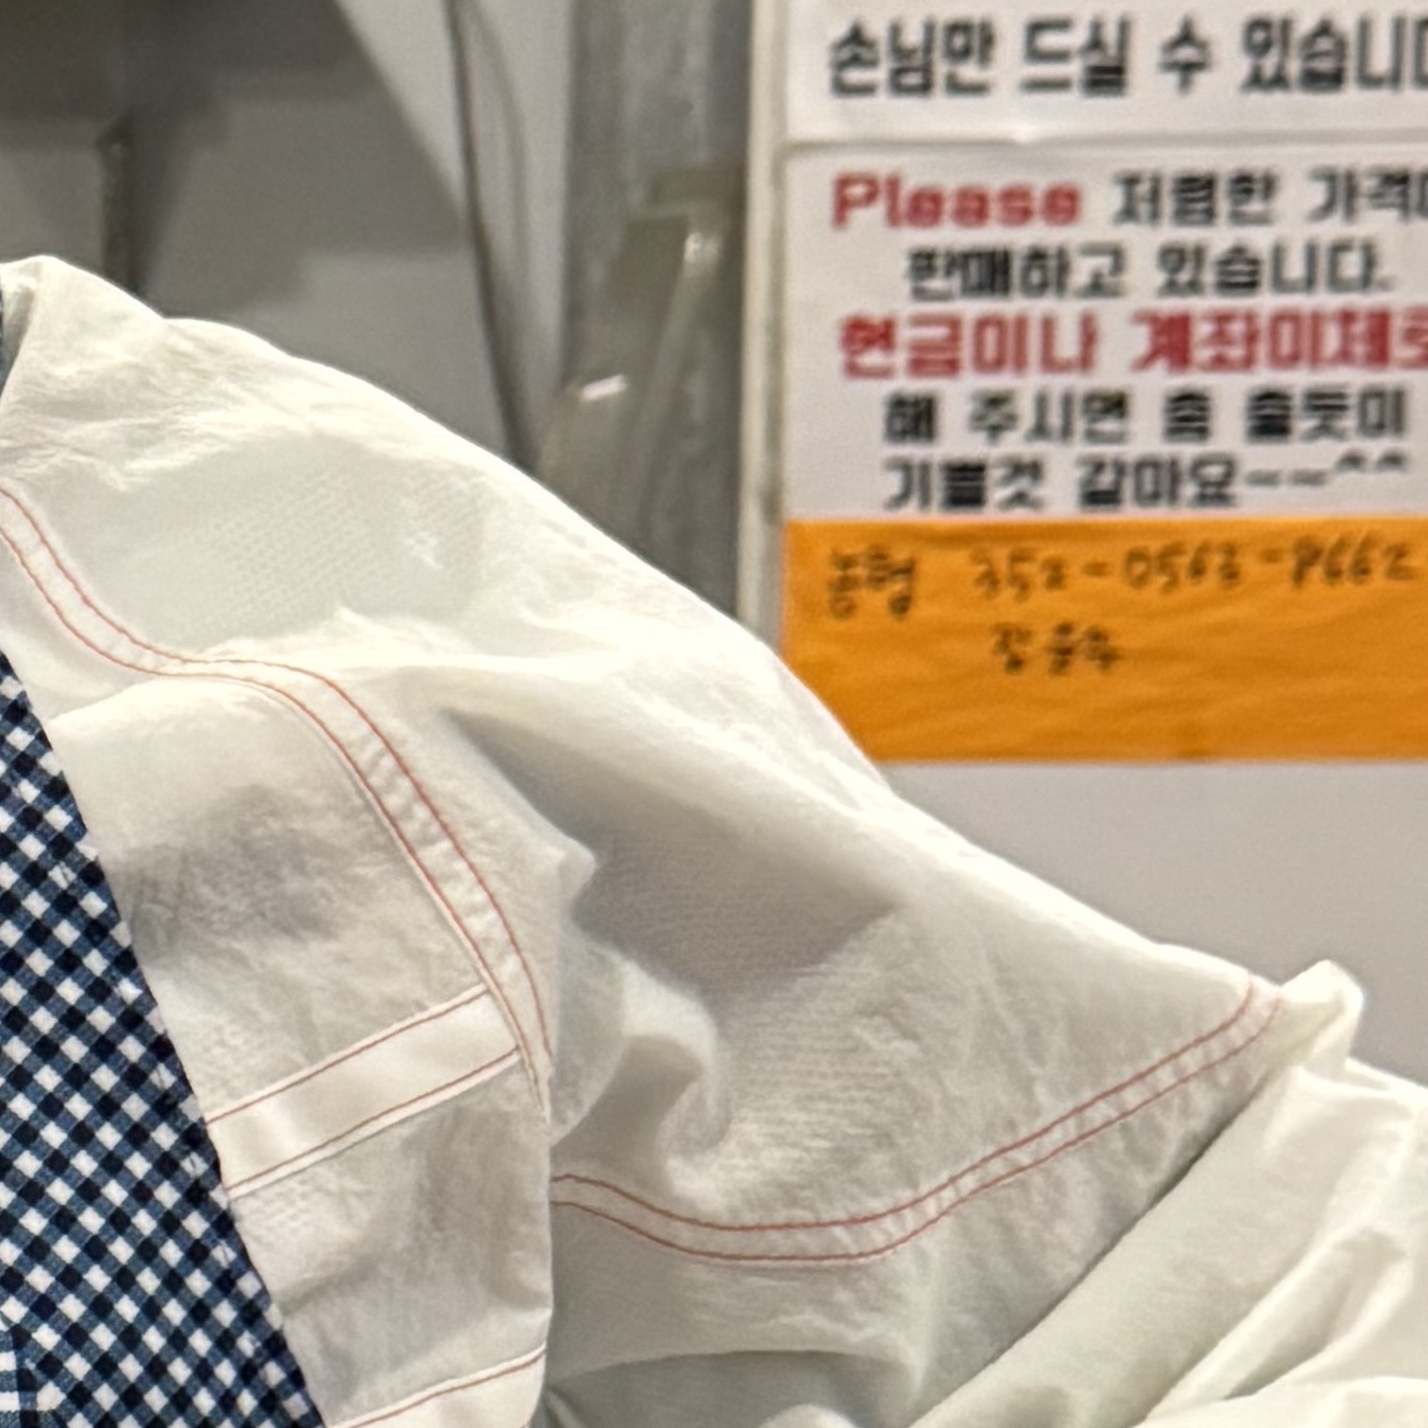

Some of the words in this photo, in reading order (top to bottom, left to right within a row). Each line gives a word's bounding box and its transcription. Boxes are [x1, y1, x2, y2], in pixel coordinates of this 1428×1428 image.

[830, 18, 996, 98] 손님만
[1023, 18, 1130, 96] 드실
[1160, 18, 1213, 94] 수
[832, 172, 1082, 230] Please
[1116, 172, 1277, 227] 저렴한
[1309, 167, 1428, 222] 가격
[908, 244, 1126, 300] 판매하고
[1157, 239, 1392, 298] 있습니다.
[840, 312, 1099, 379] 현금이나
[885, 392, 937, 444] 해
[970, 390, 1130, 444] 주시면
[888, 458, 1044, 512] 기쁠것
